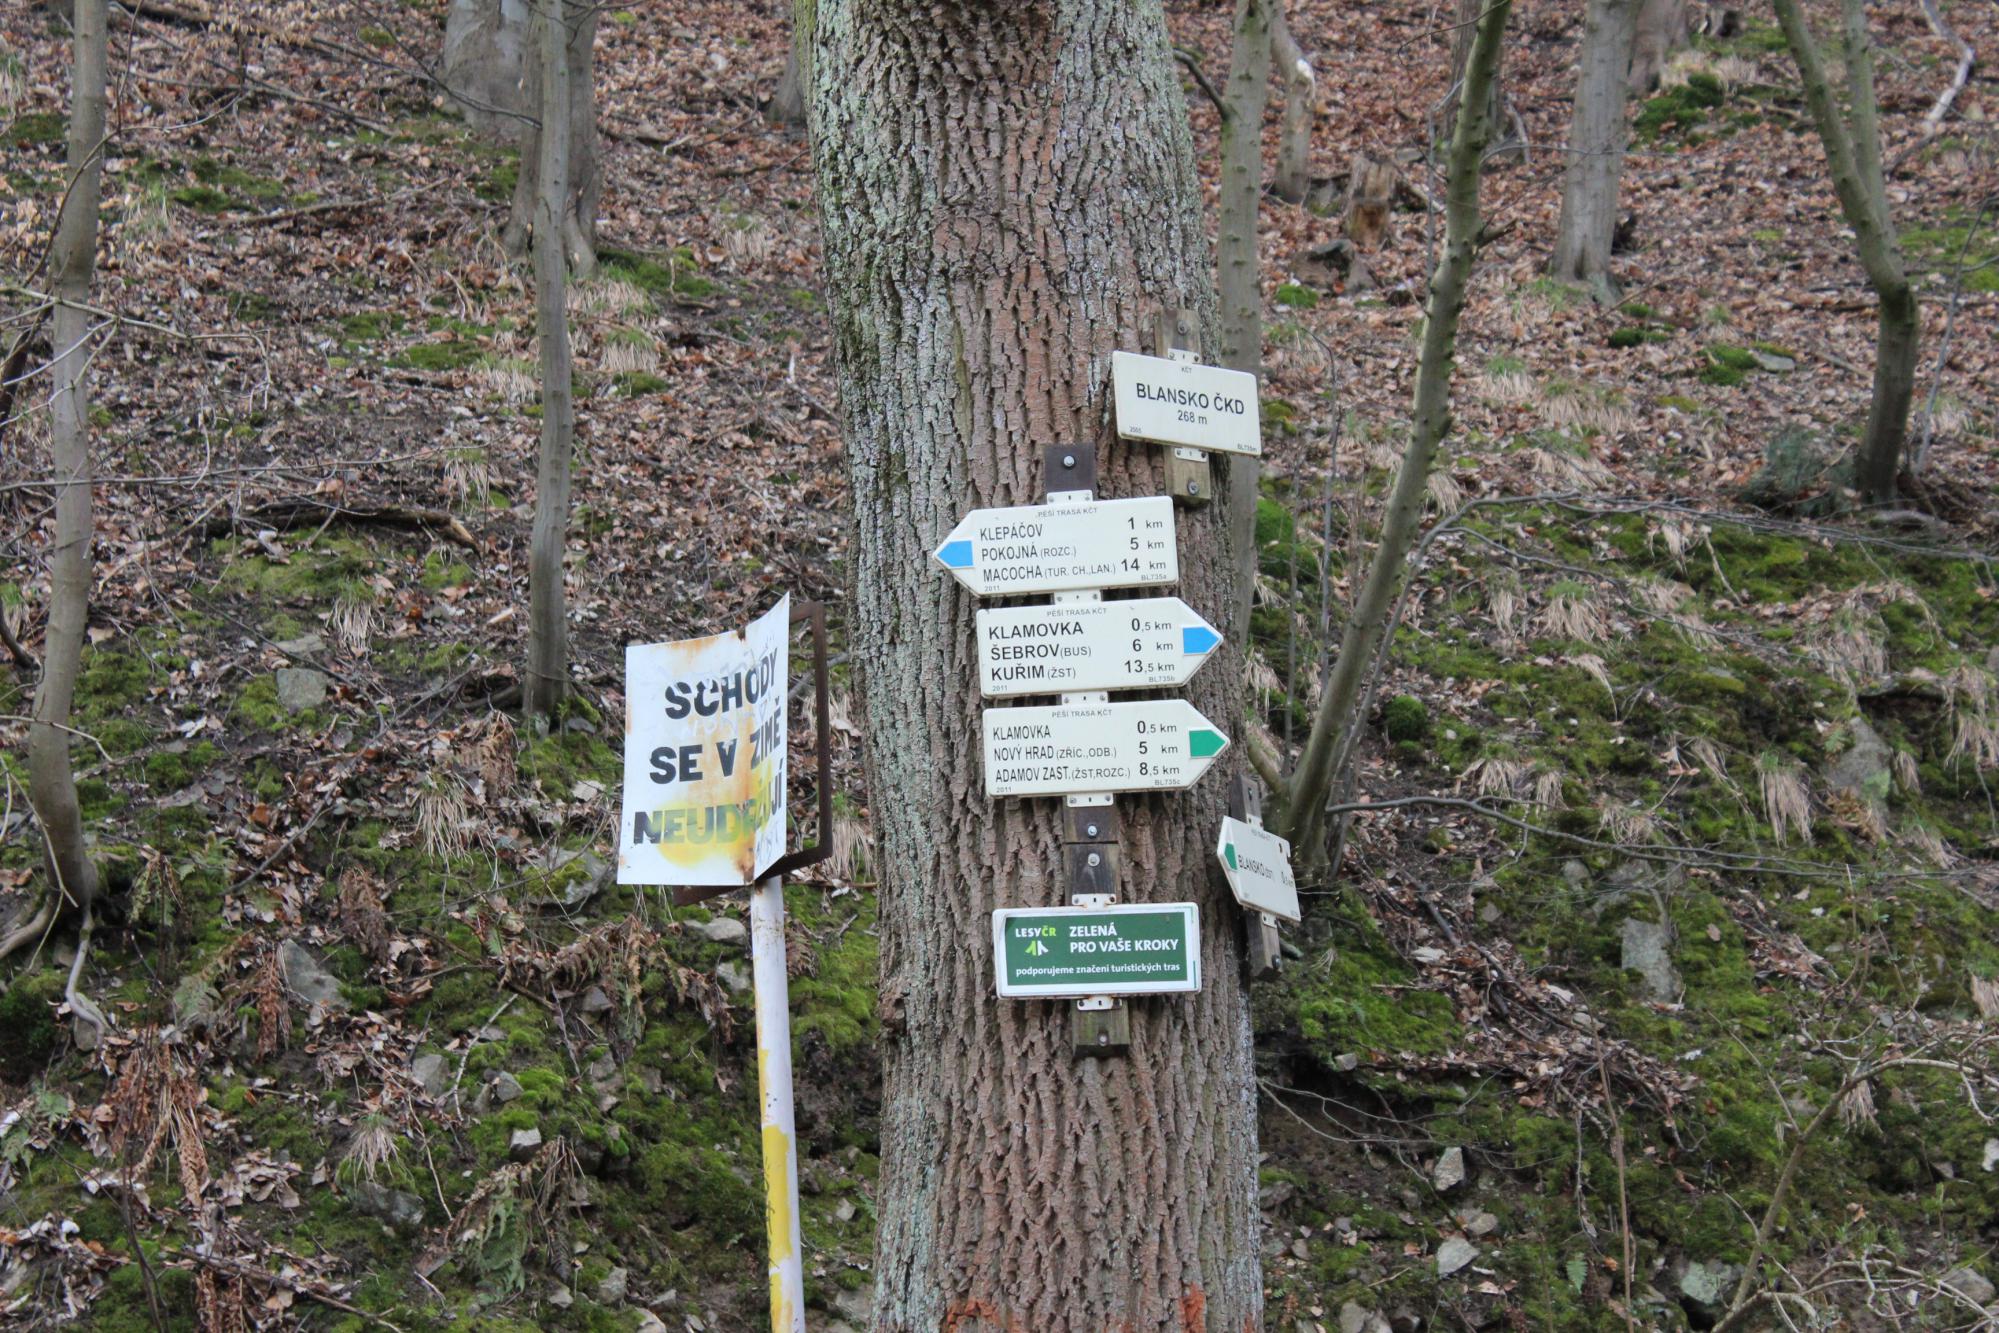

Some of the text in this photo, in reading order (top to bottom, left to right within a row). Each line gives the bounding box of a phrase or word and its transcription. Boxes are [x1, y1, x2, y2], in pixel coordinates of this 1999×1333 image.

[1136, 382, 1244, 414] BLANSKO ČKD
[1177, 410, 1207, 425] 268 m
[979, 517, 1163, 541] KLEPÁČOV 1 km
[982, 537, 1165, 561] POKOJNÁ (ROZC.) 5 km
[983, 565, 1042, 582] MACOCHA
[1044, 567, 1069, 579] (TUR.
[1120, 558, 1140, 572] 14
[1149, 560, 1166, 570] km
[988, 618, 1172, 640] KLAMOVKA 0,5 km
[1132, 639, 1142, 652] 6
[1156, 642, 1174, 651] km
[991, 660, 1175, 681] KUŘIM (ŽST) 13,5 km
[665, 647, 778, 720] SCHODY
[650, 696, 782, 785] SE V ZIMĚ
[993, 720, 1177, 741] KLAMOVKA 0,5 km
[994, 743, 1023, 761] NOVÝ
[1025, 745, 1054, 760] HRAD
[1138, 741, 1148, 755] 5
[1161, 744, 1178, 754] km
[995, 768, 1040, 783] ADAMOV
[1139, 762, 1159, 776] 8,5
[1162, 766, 1180, 775] km
[1069, 922, 1117, 937] ZELENÁ
[1070, 937, 1179, 953] PRO VAŠE KROKY
[1016, 963, 1181, 977] podporujeme značení turistických tras
